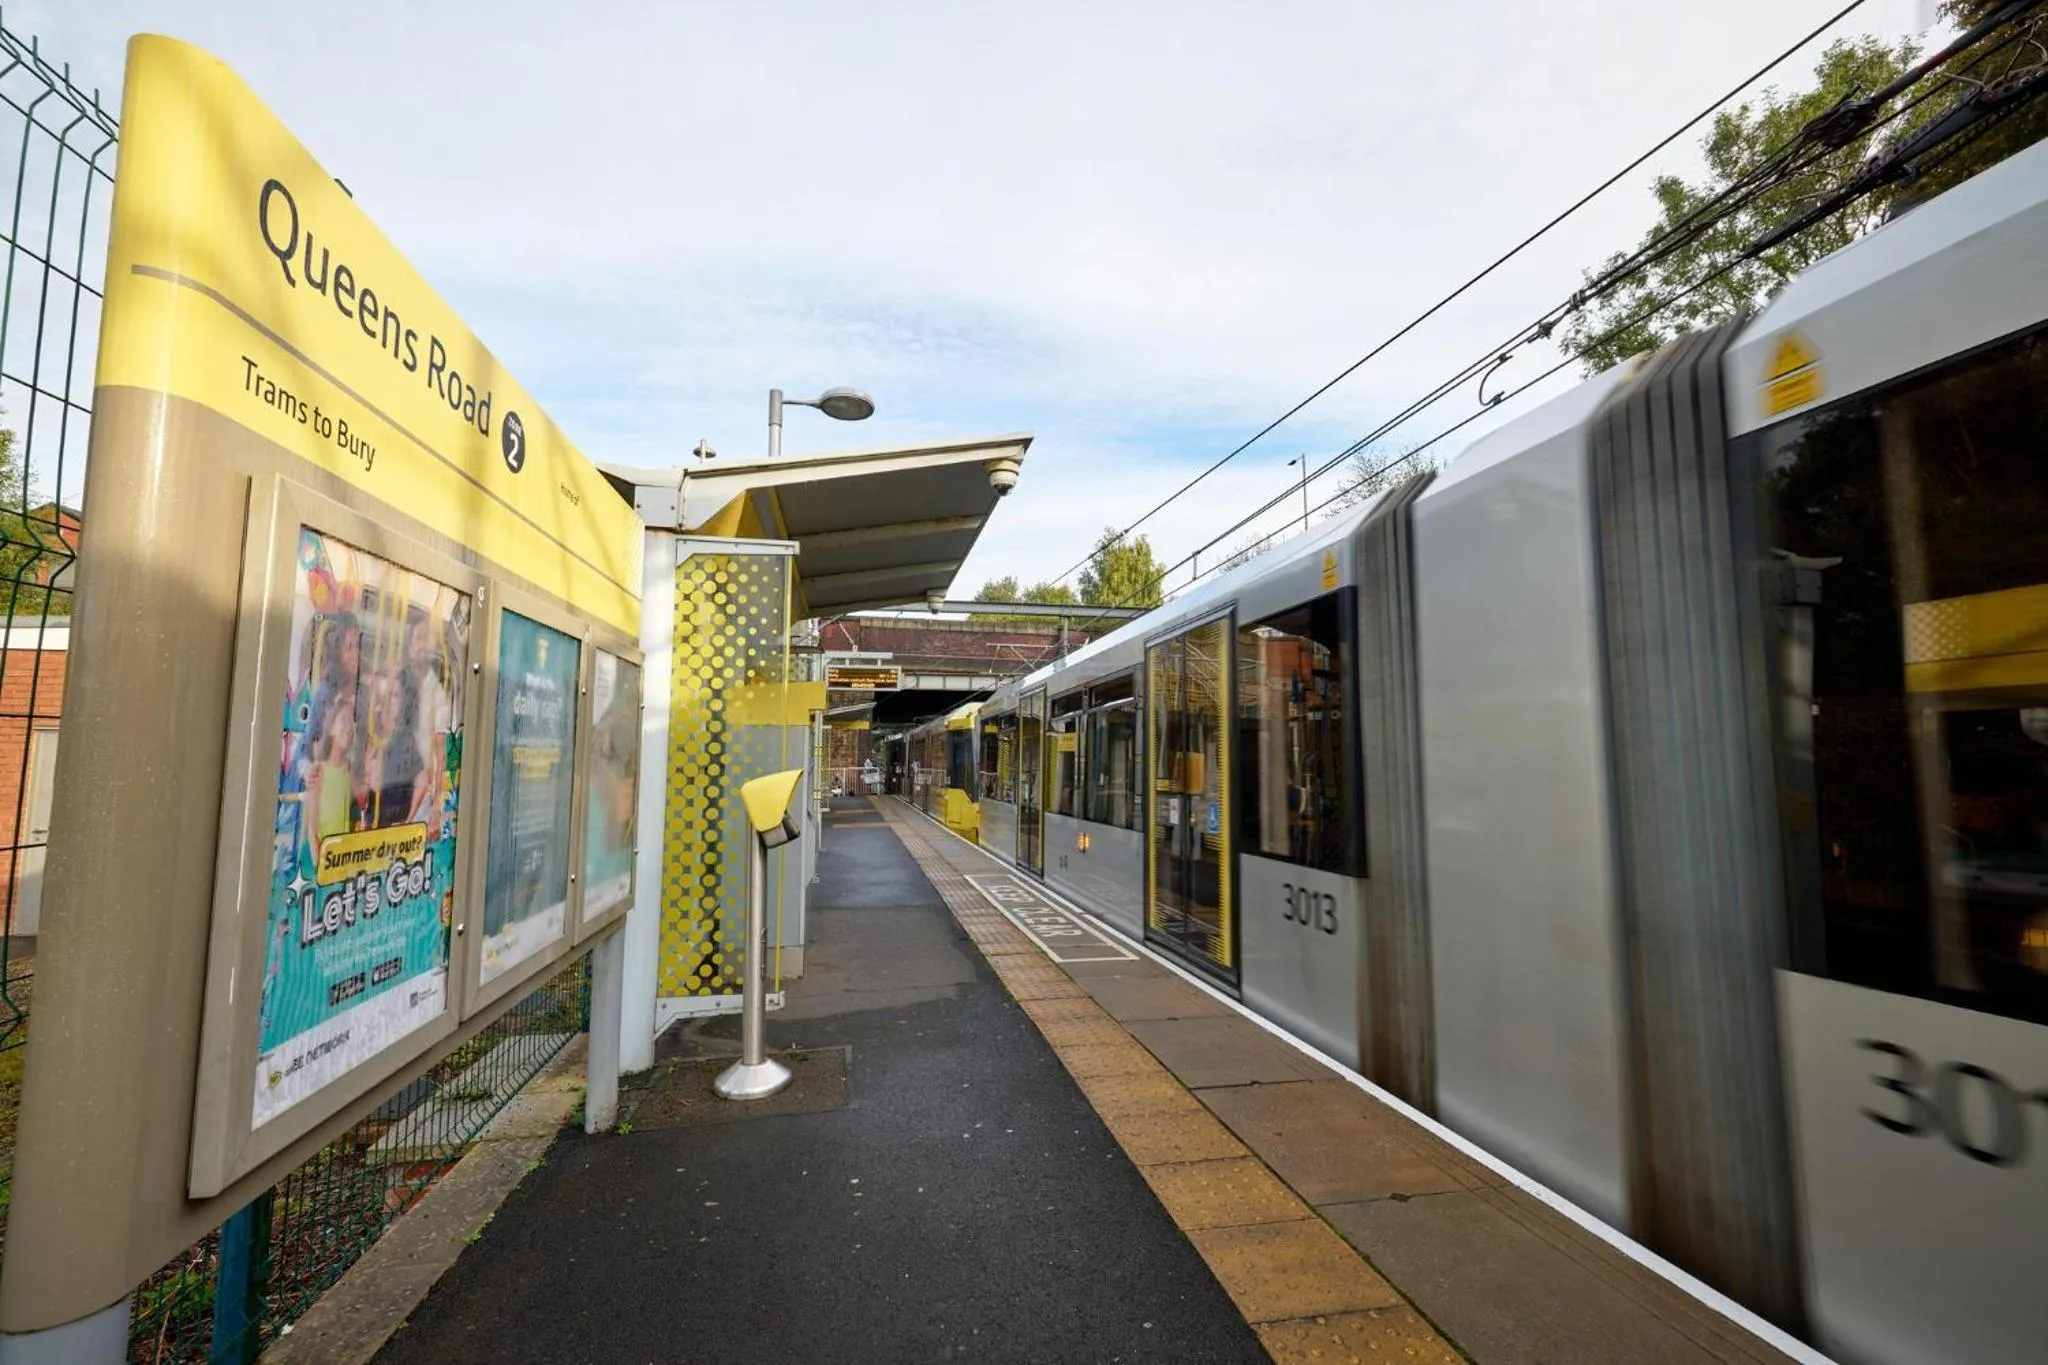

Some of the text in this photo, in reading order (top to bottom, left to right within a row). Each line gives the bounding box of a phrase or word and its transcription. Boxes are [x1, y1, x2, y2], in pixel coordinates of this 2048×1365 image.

[259, 178, 493, 437] Queens Road
[241, 355, 376, 472] Trams to Bury
[507, 433, 519, 468] 2
[324, 835, 423, 870] Summer day out?
[303, 871, 380, 944] Let's
[386, 848, 434, 906] Go!
[1012, 907, 1082, 937] CLEAR
[1281, 882, 1339, 935] 3013
